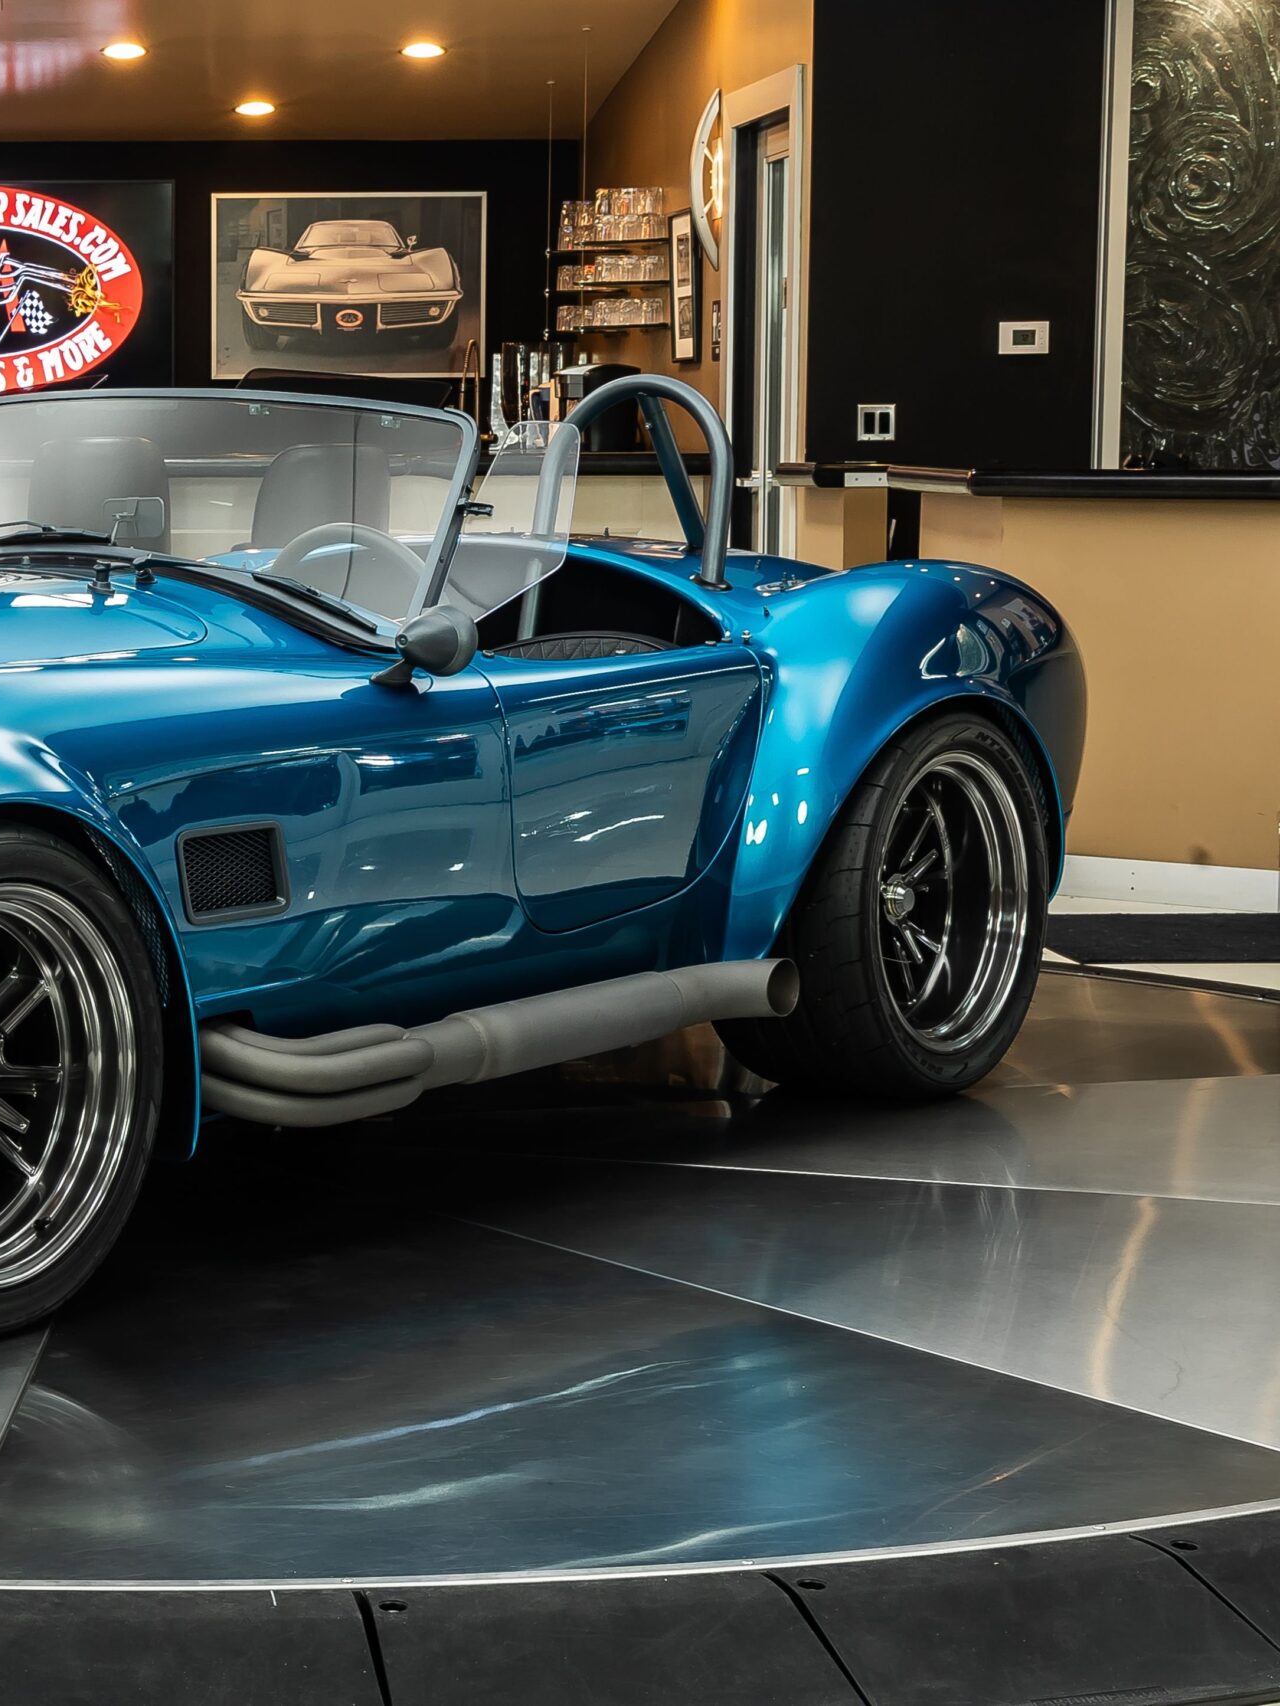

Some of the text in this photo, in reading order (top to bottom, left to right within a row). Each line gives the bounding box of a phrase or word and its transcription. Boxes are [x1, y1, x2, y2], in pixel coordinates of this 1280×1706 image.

[10, 192, 132, 282] SALES.COM
[12, 355, 35, 391] &
[36, 320, 113, 383] MORE
